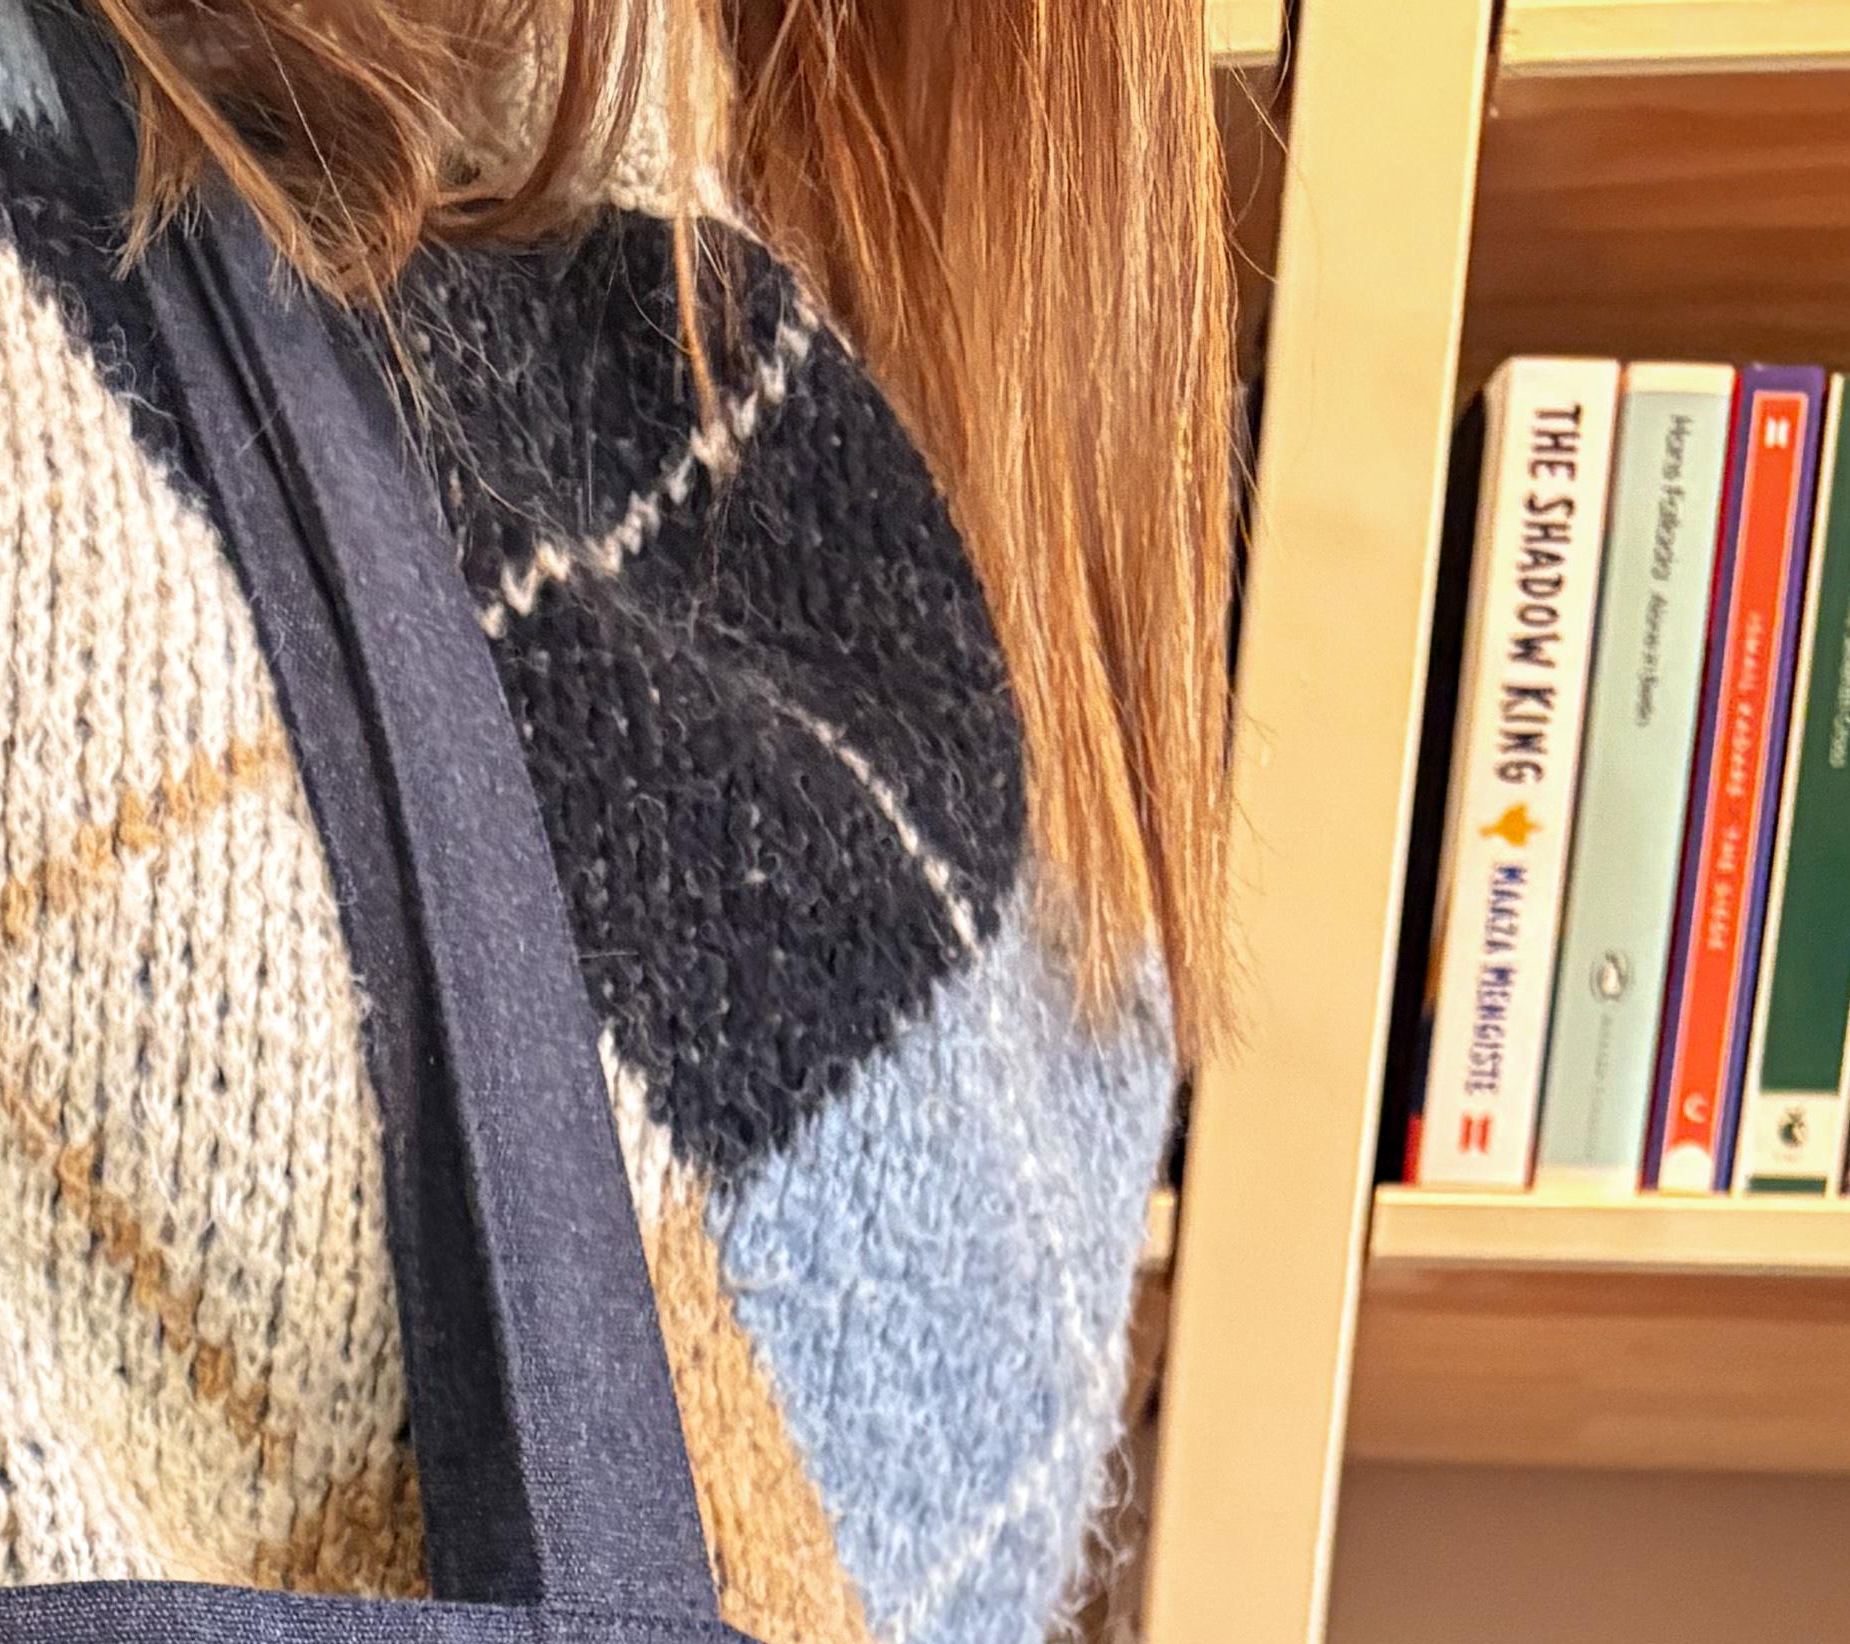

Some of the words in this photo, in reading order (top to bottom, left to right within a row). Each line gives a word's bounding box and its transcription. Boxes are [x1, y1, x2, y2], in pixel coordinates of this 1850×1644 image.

[1528, 403, 1584, 483] THE
[1508, 493, 1574, 671] SHADOW
[1492, 680, 1555, 787] KING
